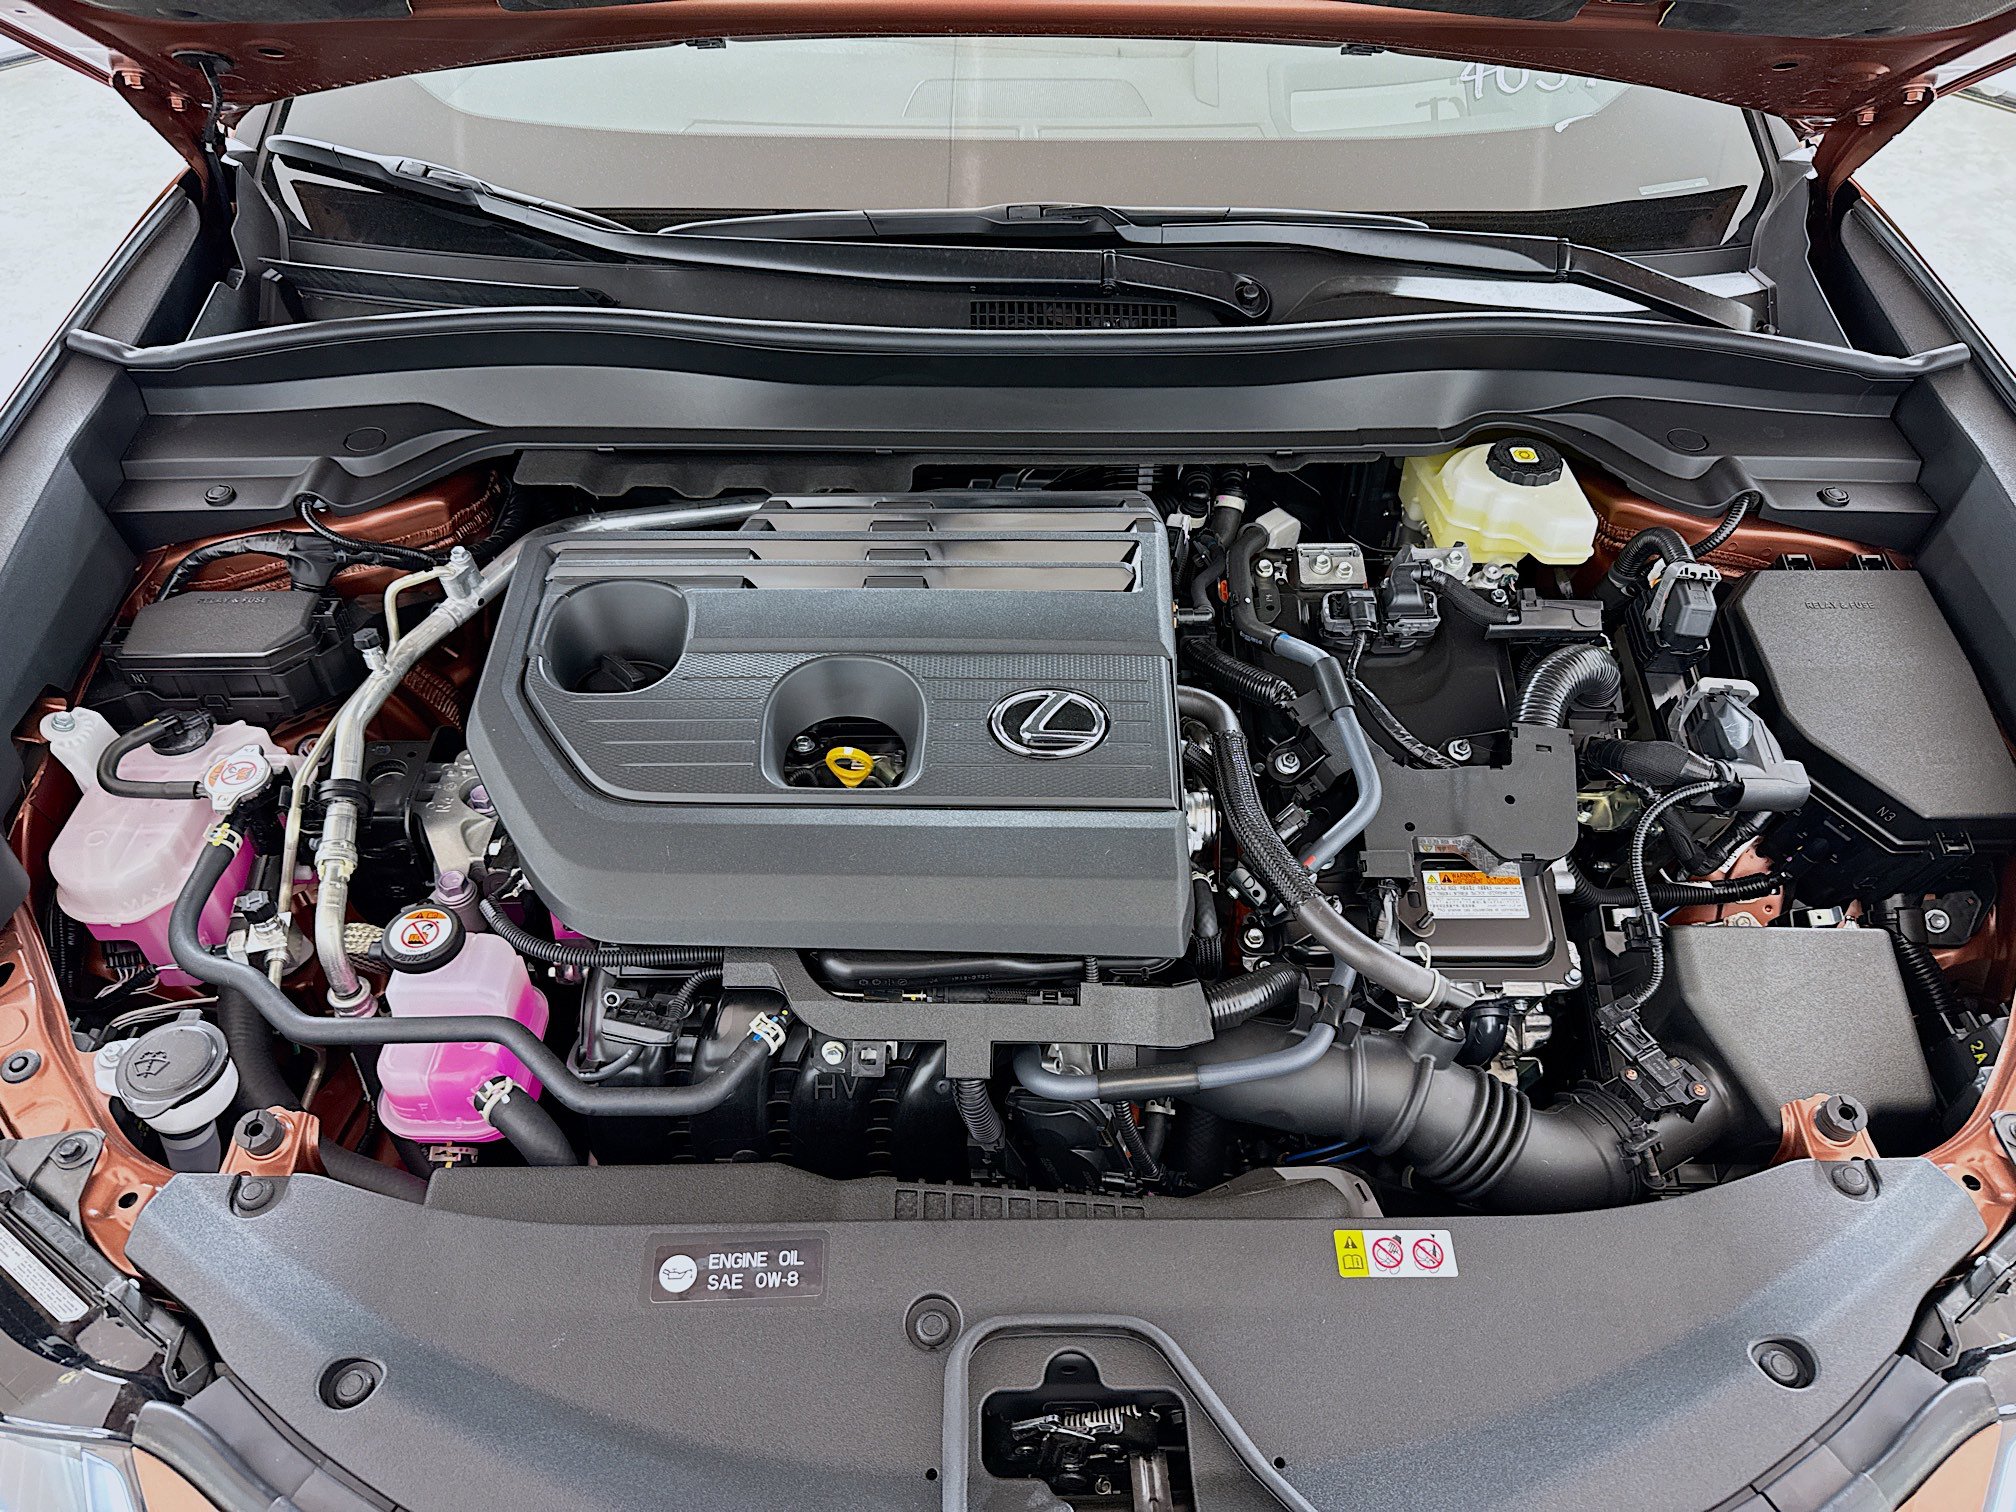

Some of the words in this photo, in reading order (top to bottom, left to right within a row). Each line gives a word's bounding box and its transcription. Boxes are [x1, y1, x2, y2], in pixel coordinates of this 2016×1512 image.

[241, 596, 269, 604] FUSE
[1804, 601, 1836, 610] RELAY
[1849, 601, 1876, 610] FUSE
[1876, 806, 1897, 822] N3
[393, 952, 432, 961] DENSO
[1969, 1040, 1989, 1065] 2A
[814, 1073, 859, 1100] HV
[708, 1251, 769, 1270] ENGINE
[778, 1250, 804, 1266] OIL
[707, 1273, 744, 1291] SAE
